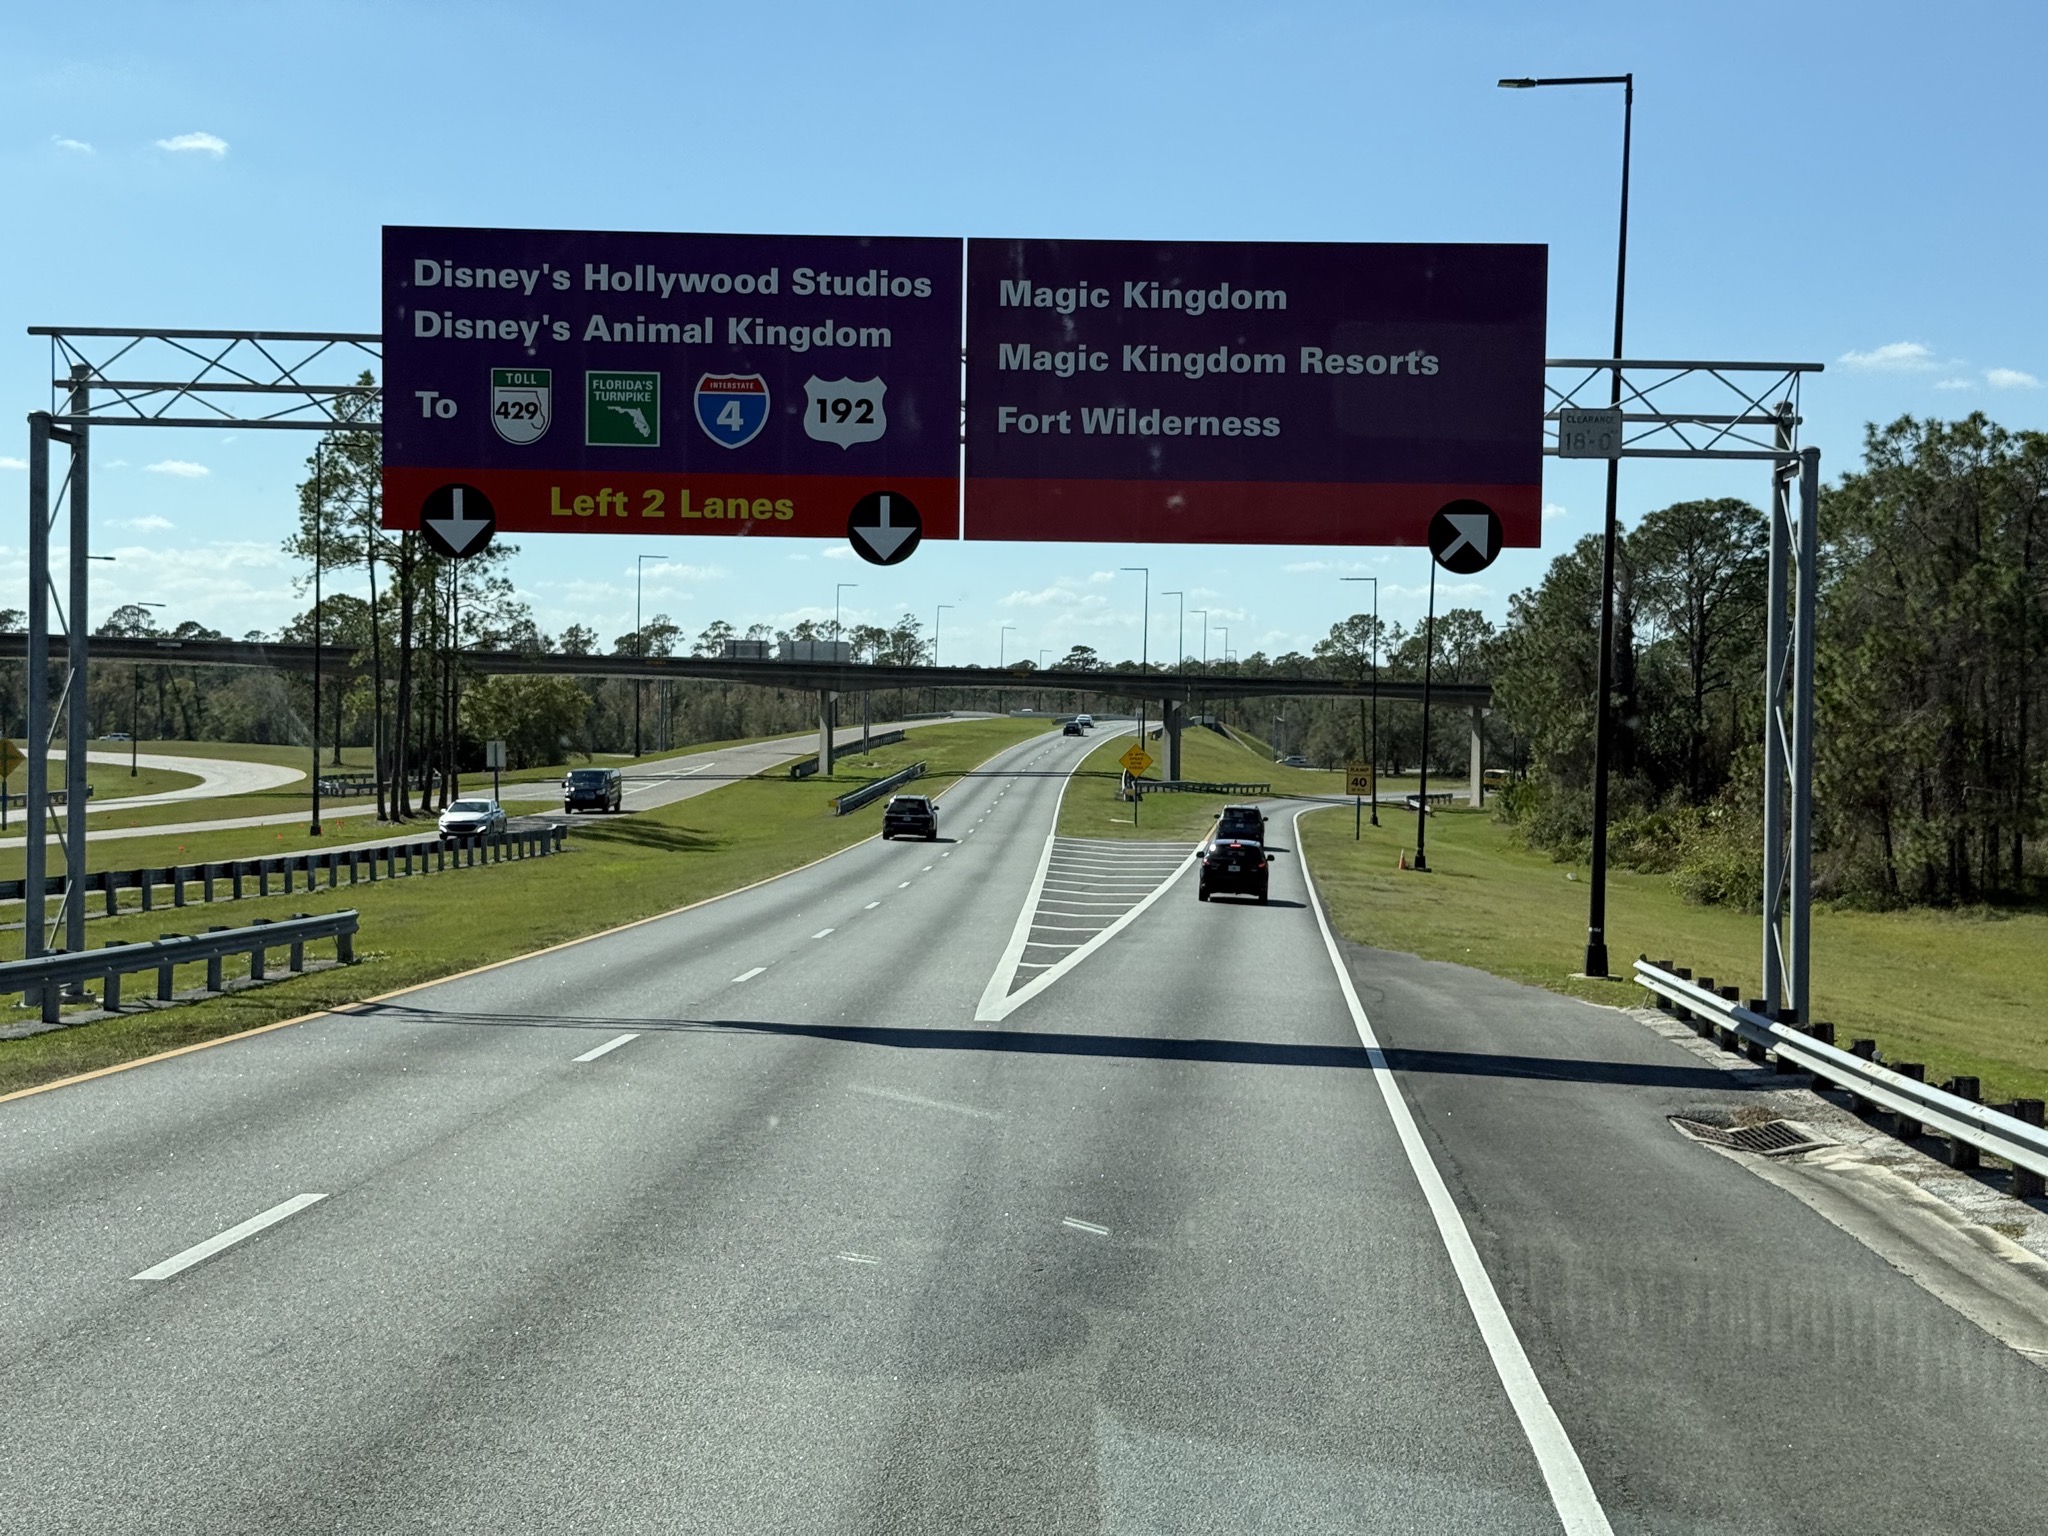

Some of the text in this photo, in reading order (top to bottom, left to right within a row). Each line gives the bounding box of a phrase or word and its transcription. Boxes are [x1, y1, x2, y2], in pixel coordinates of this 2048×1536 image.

[414, 258, 932, 299] Disney's Hollywood Studios
[999, 280, 1287, 316] Magic Kingdom
[414, 310, 892, 353] Disney's Animal Kingdom
[998, 343, 1439, 380] Magic Kingdom Resorts
[505, 372, 537, 385] TOLL
[592, 379, 653, 391] FLORIDA'S
[710, 381, 755, 390] INTERSTATE
[414, 390, 458, 419] To
[593, 390, 652, 402] TURNPIKE
[495, 401, 539, 420] 429
[716, 400, 744, 432] 4
[816, 398, 875, 424] 192
[998, 406, 1281, 437] Fort Wilderness
[1566, 415, 1617, 424] CLEARANCE
[551, 486, 795, 520] Left 2 Lanes
[1351, 777, 1367, 787] 40
